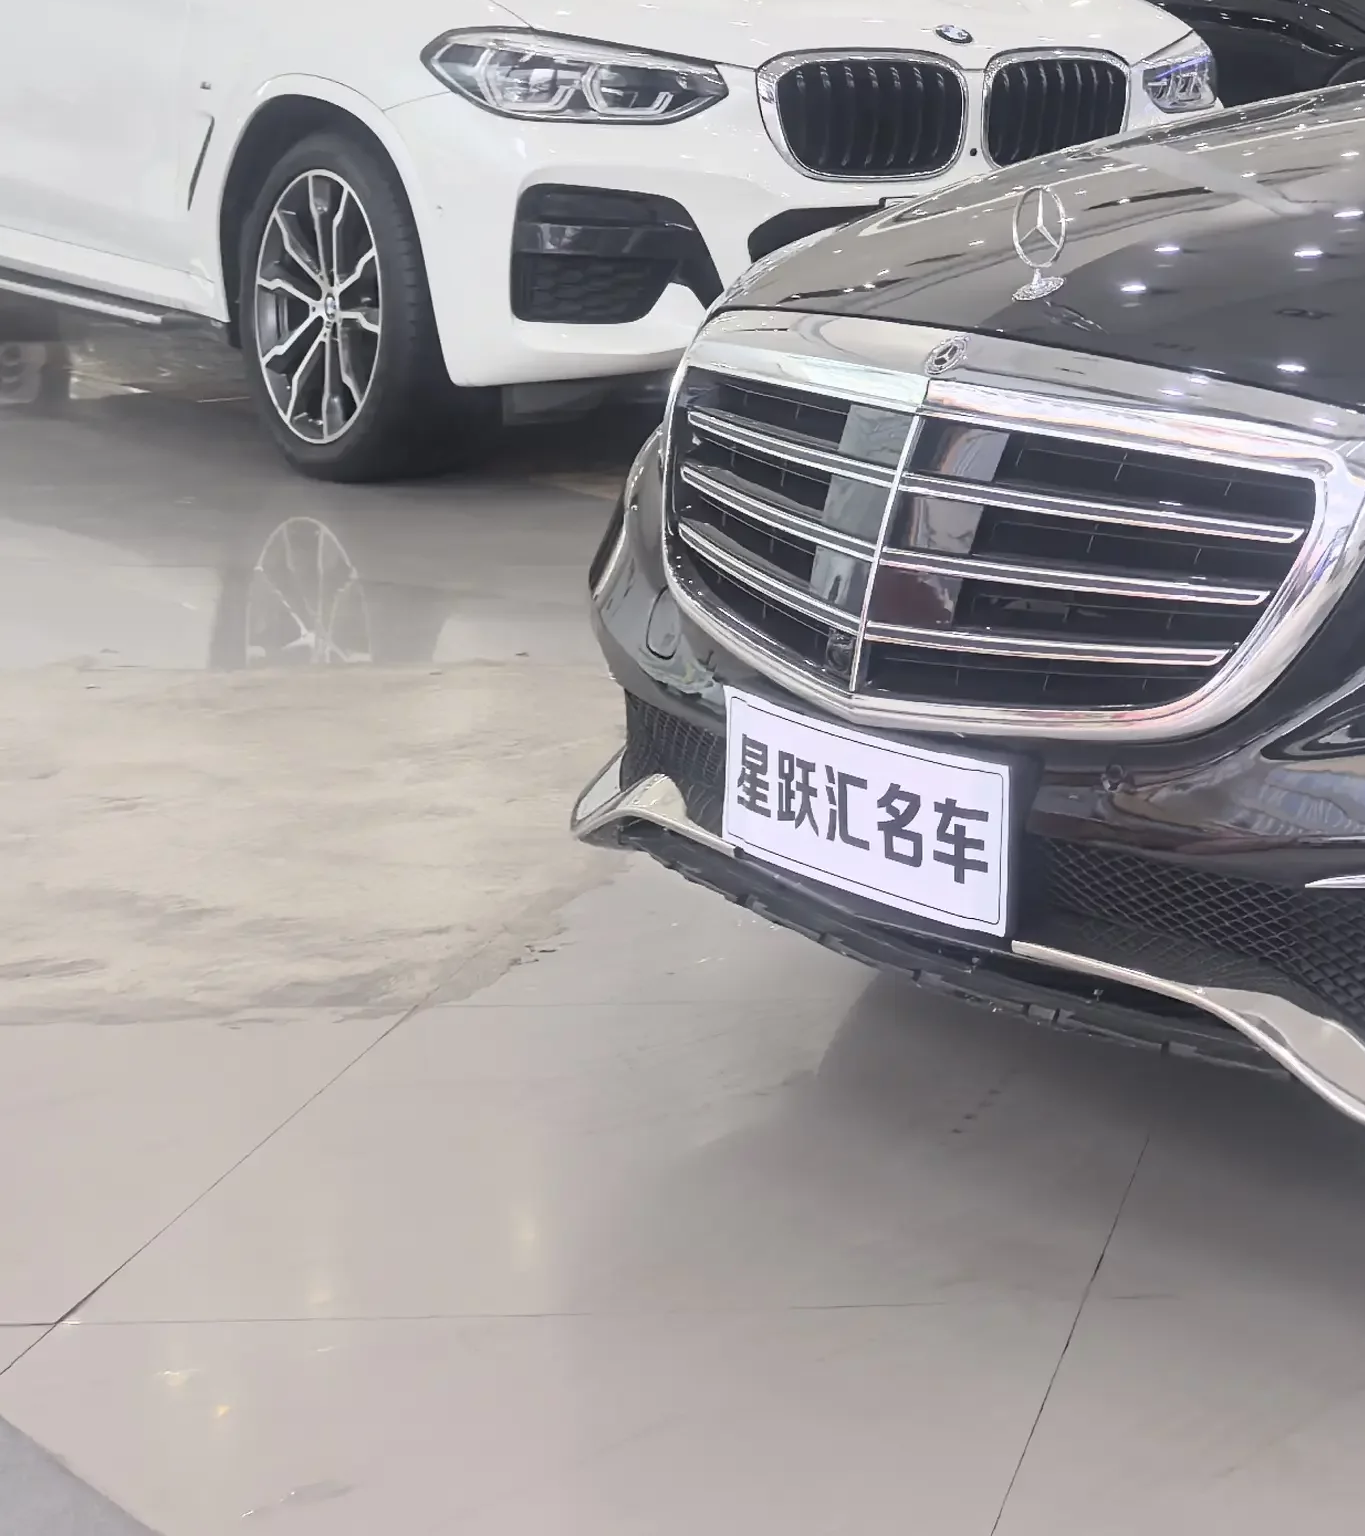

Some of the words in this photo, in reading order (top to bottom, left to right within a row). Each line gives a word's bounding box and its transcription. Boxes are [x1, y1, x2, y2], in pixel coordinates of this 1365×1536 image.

[737, 733, 989, 884] 星跃汇名车
